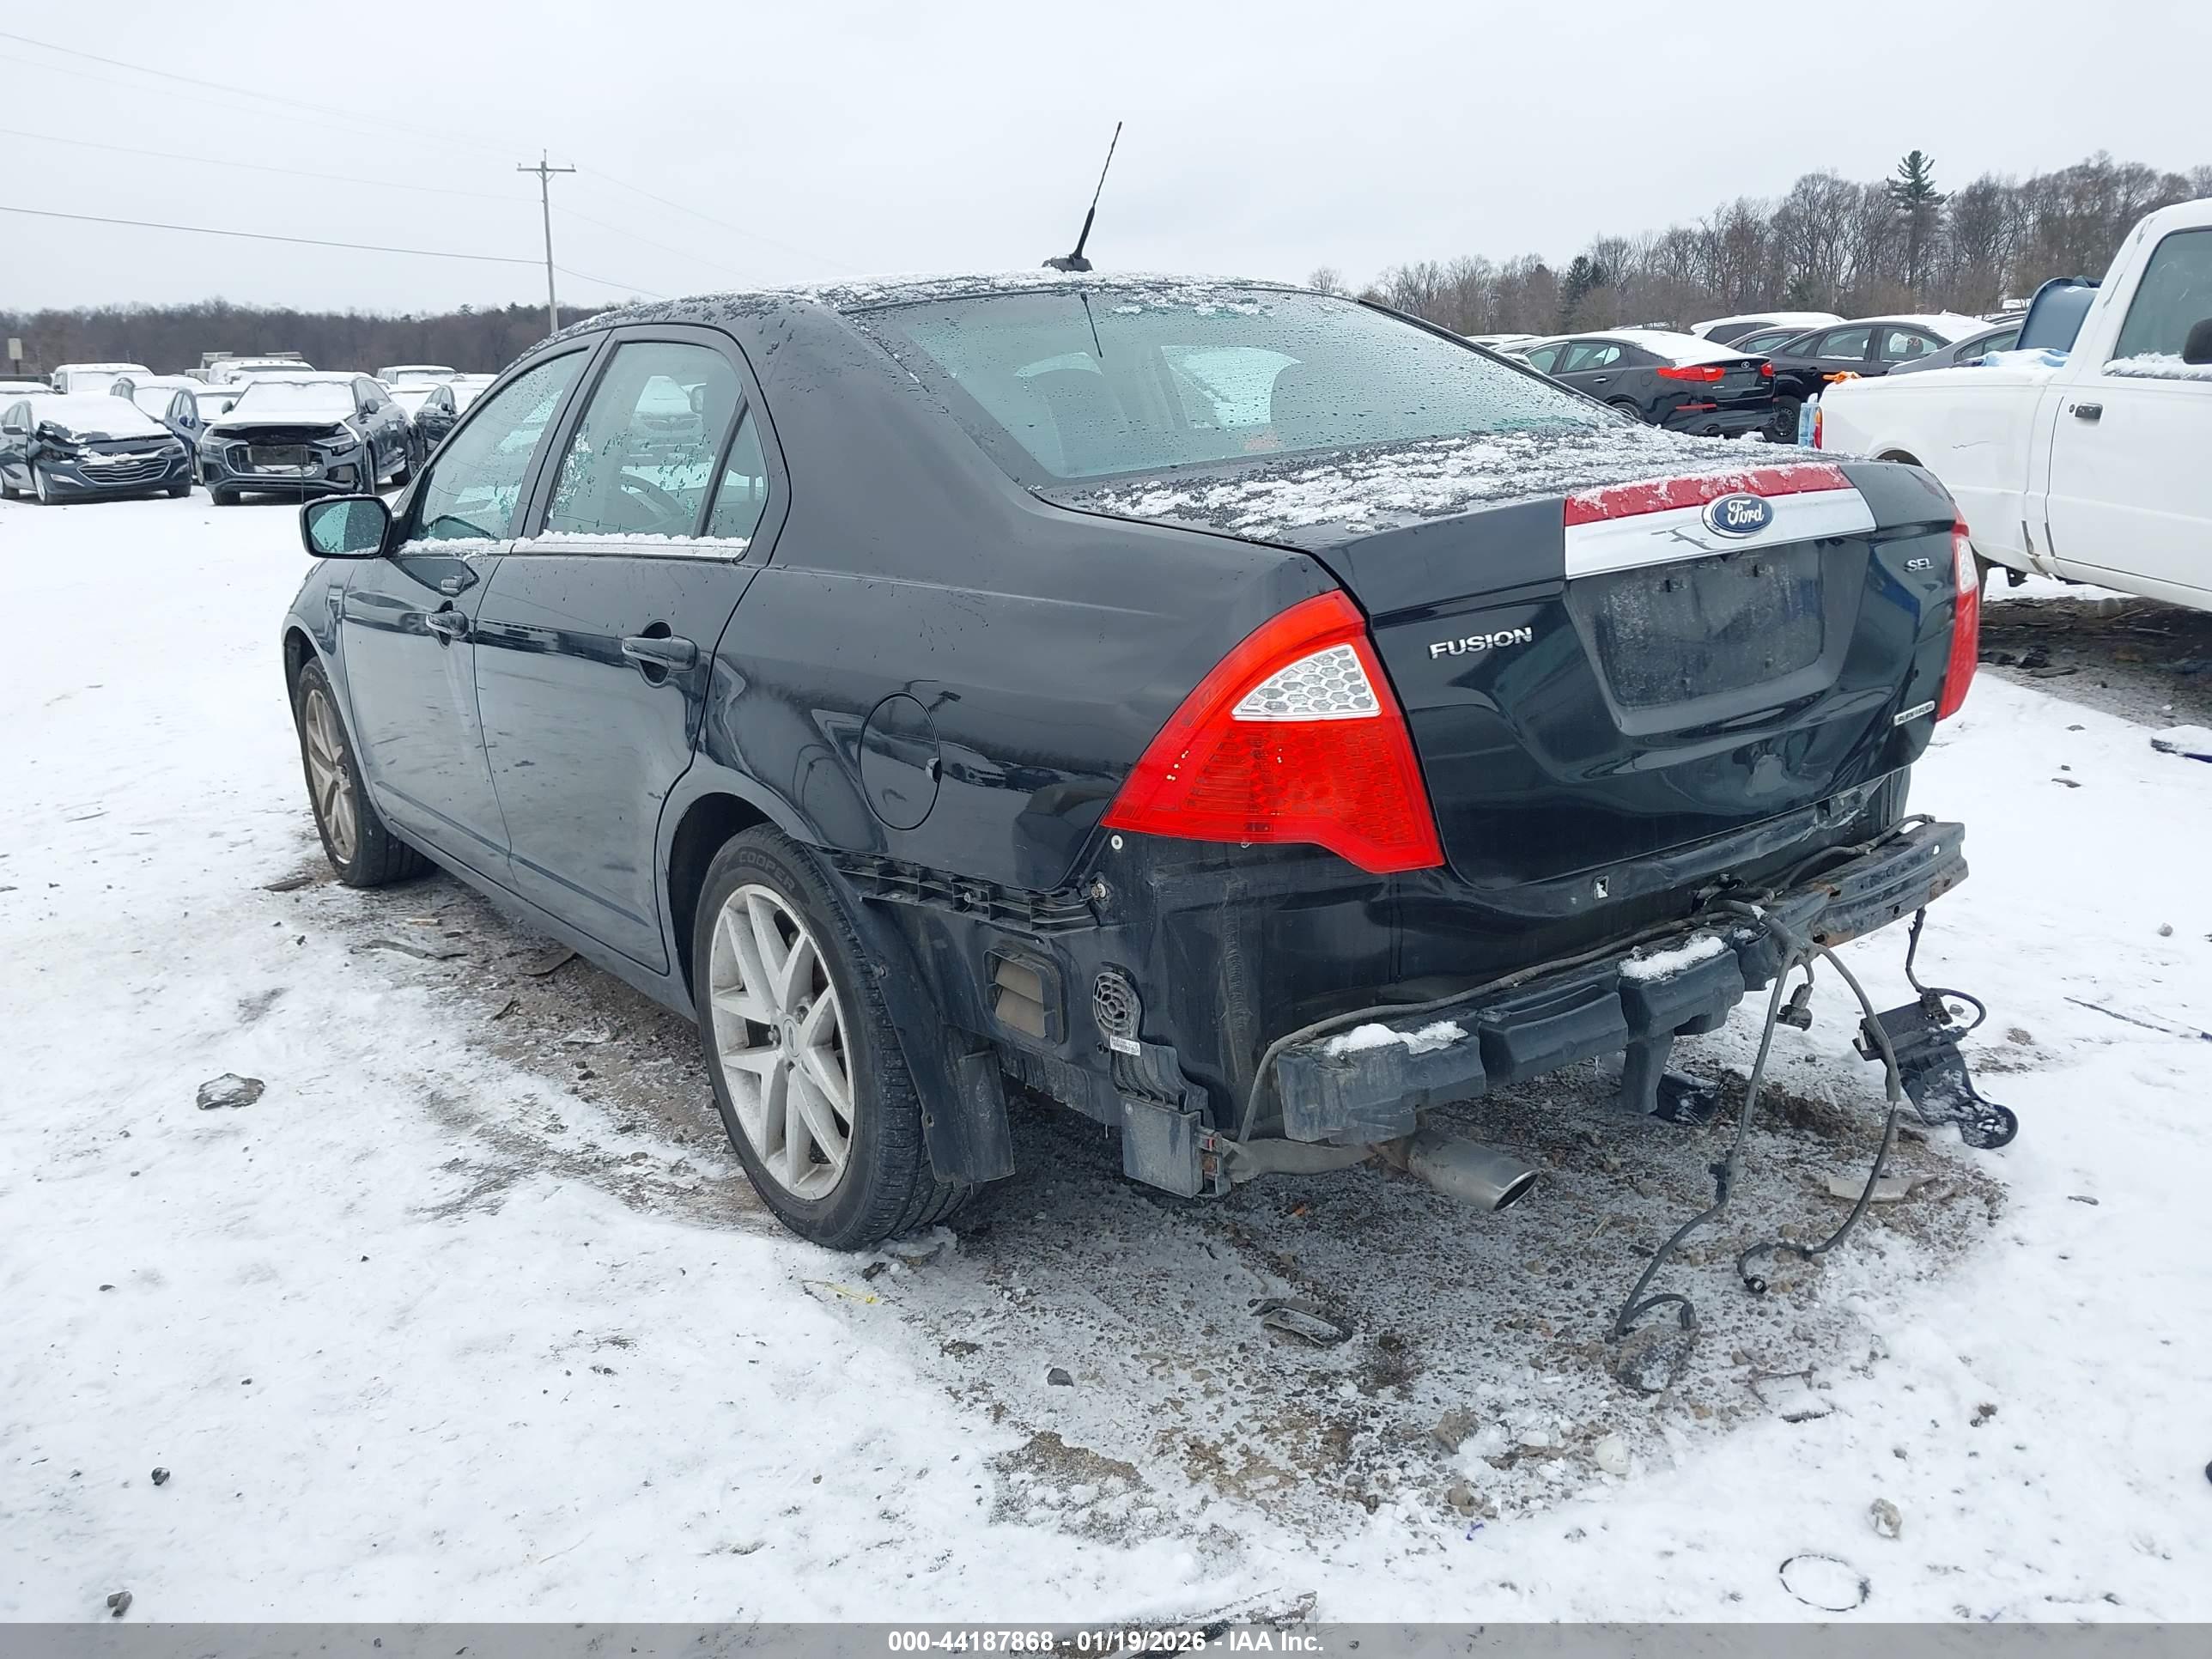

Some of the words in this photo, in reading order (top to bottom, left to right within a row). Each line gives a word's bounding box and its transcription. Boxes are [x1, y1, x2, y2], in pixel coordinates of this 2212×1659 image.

[1727, 499, 1765, 526] Ford
[1906, 557, 1935, 573] SEL
[1429, 626, 1533, 659] FUSION
[739, 851, 796, 891] COOPER
